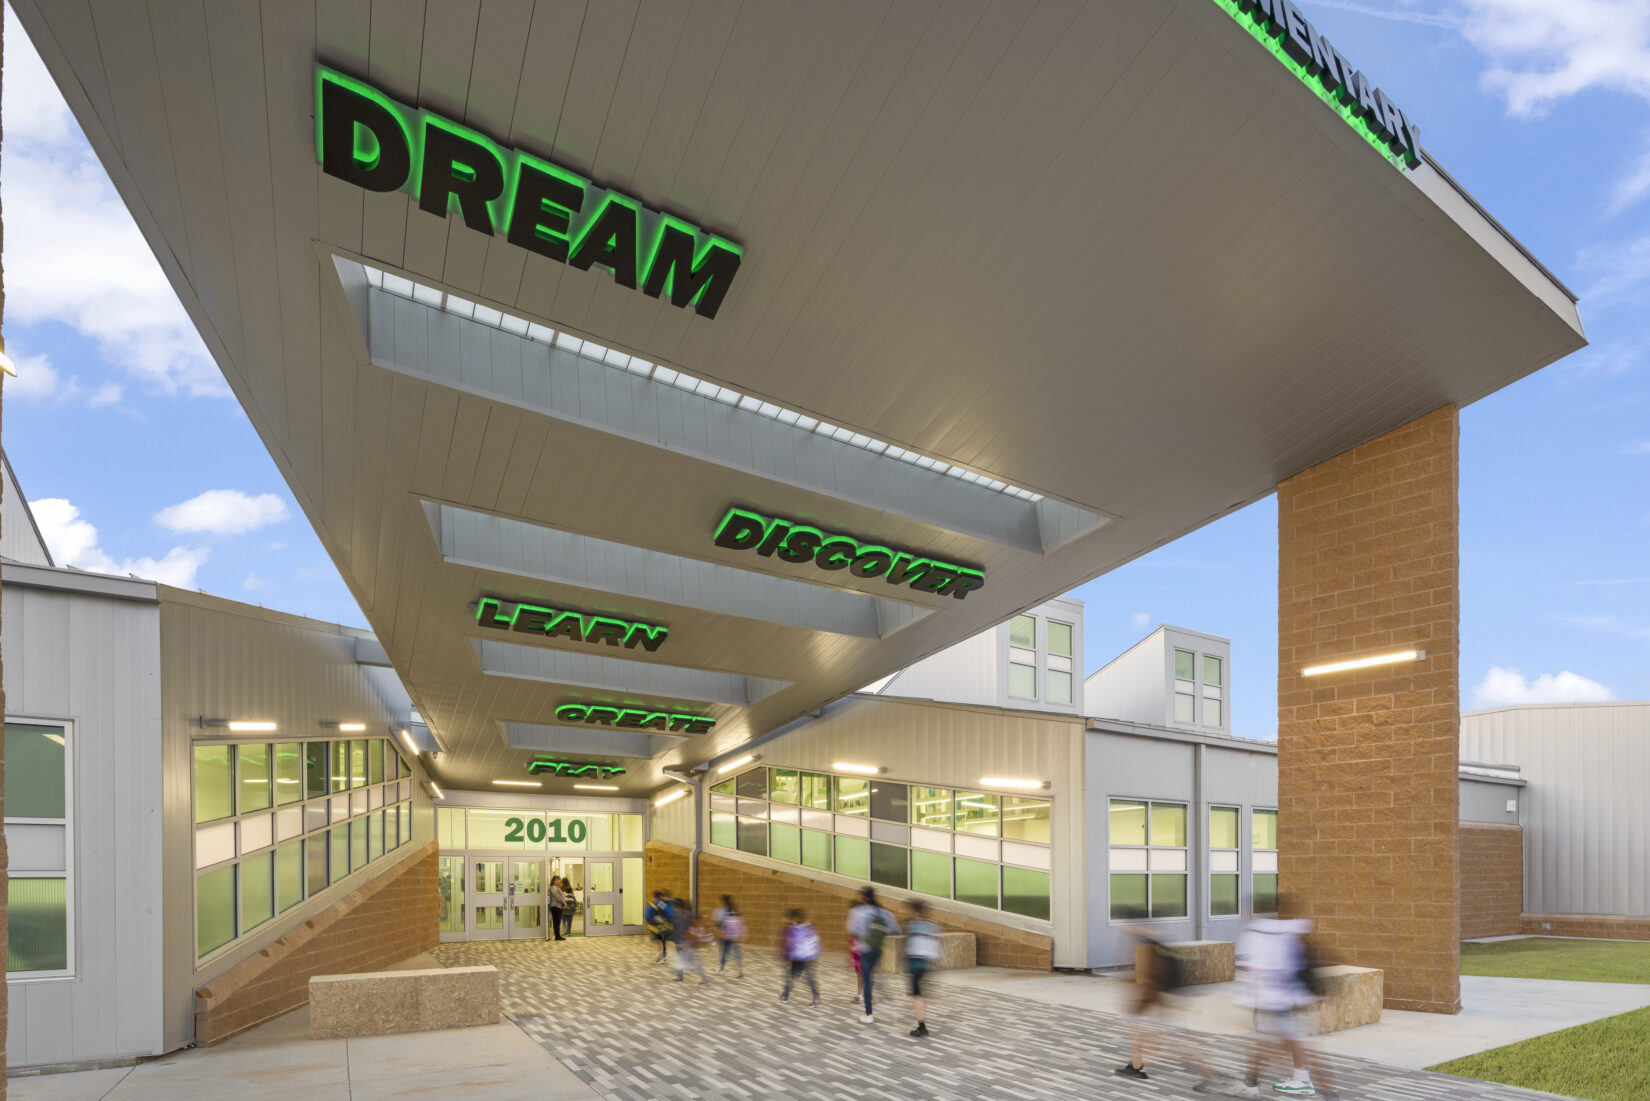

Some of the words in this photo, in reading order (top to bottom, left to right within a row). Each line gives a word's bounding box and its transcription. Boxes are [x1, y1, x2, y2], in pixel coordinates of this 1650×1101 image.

[318, 70, 744, 320] DREAM
[713, 507, 985, 600] DISCOVER
[477, 597, 668, 652] LEARN
[555, 704, 716, 735] CREATE
[528, 761, 626, 780] PLAY
[504, 817, 587, 843] 2010
